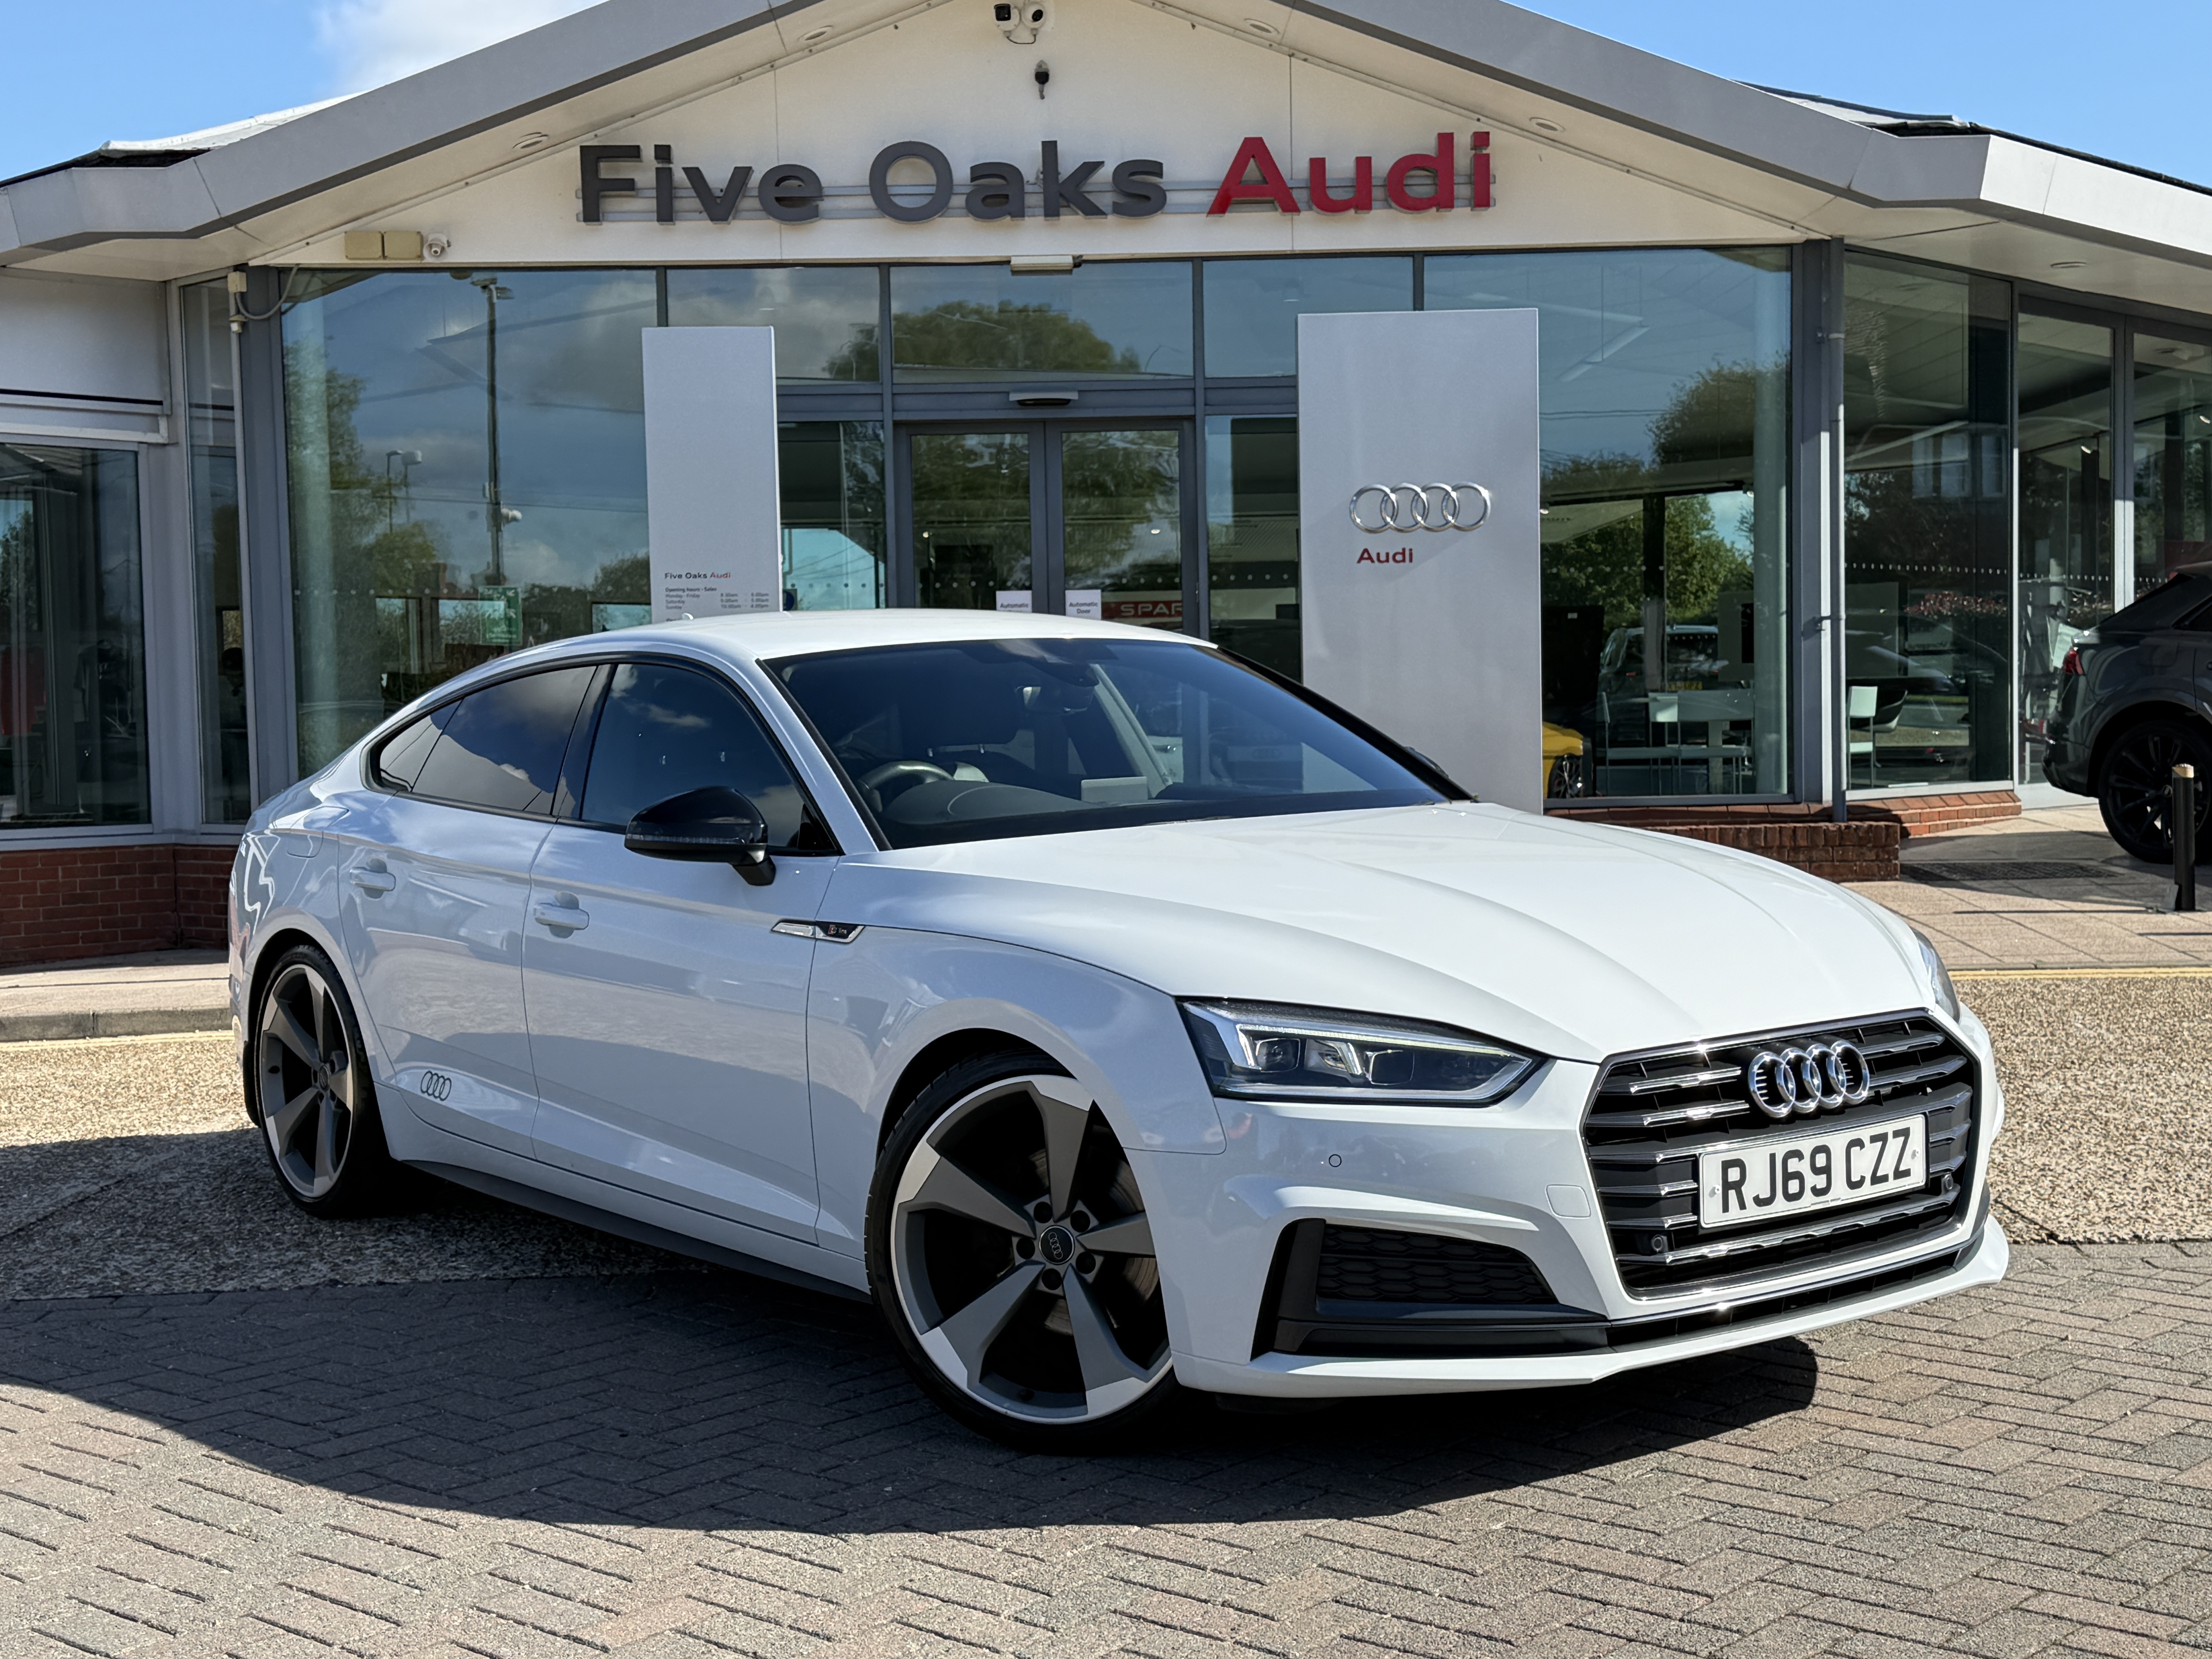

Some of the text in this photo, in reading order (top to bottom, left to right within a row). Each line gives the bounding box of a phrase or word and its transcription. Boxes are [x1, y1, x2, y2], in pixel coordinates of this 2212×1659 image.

[580, 132, 1491, 225] Five Oaks Audi
[1357, 547, 1413, 563] Audi
[1721, 1127, 1911, 1214] RJ69 CZZ
